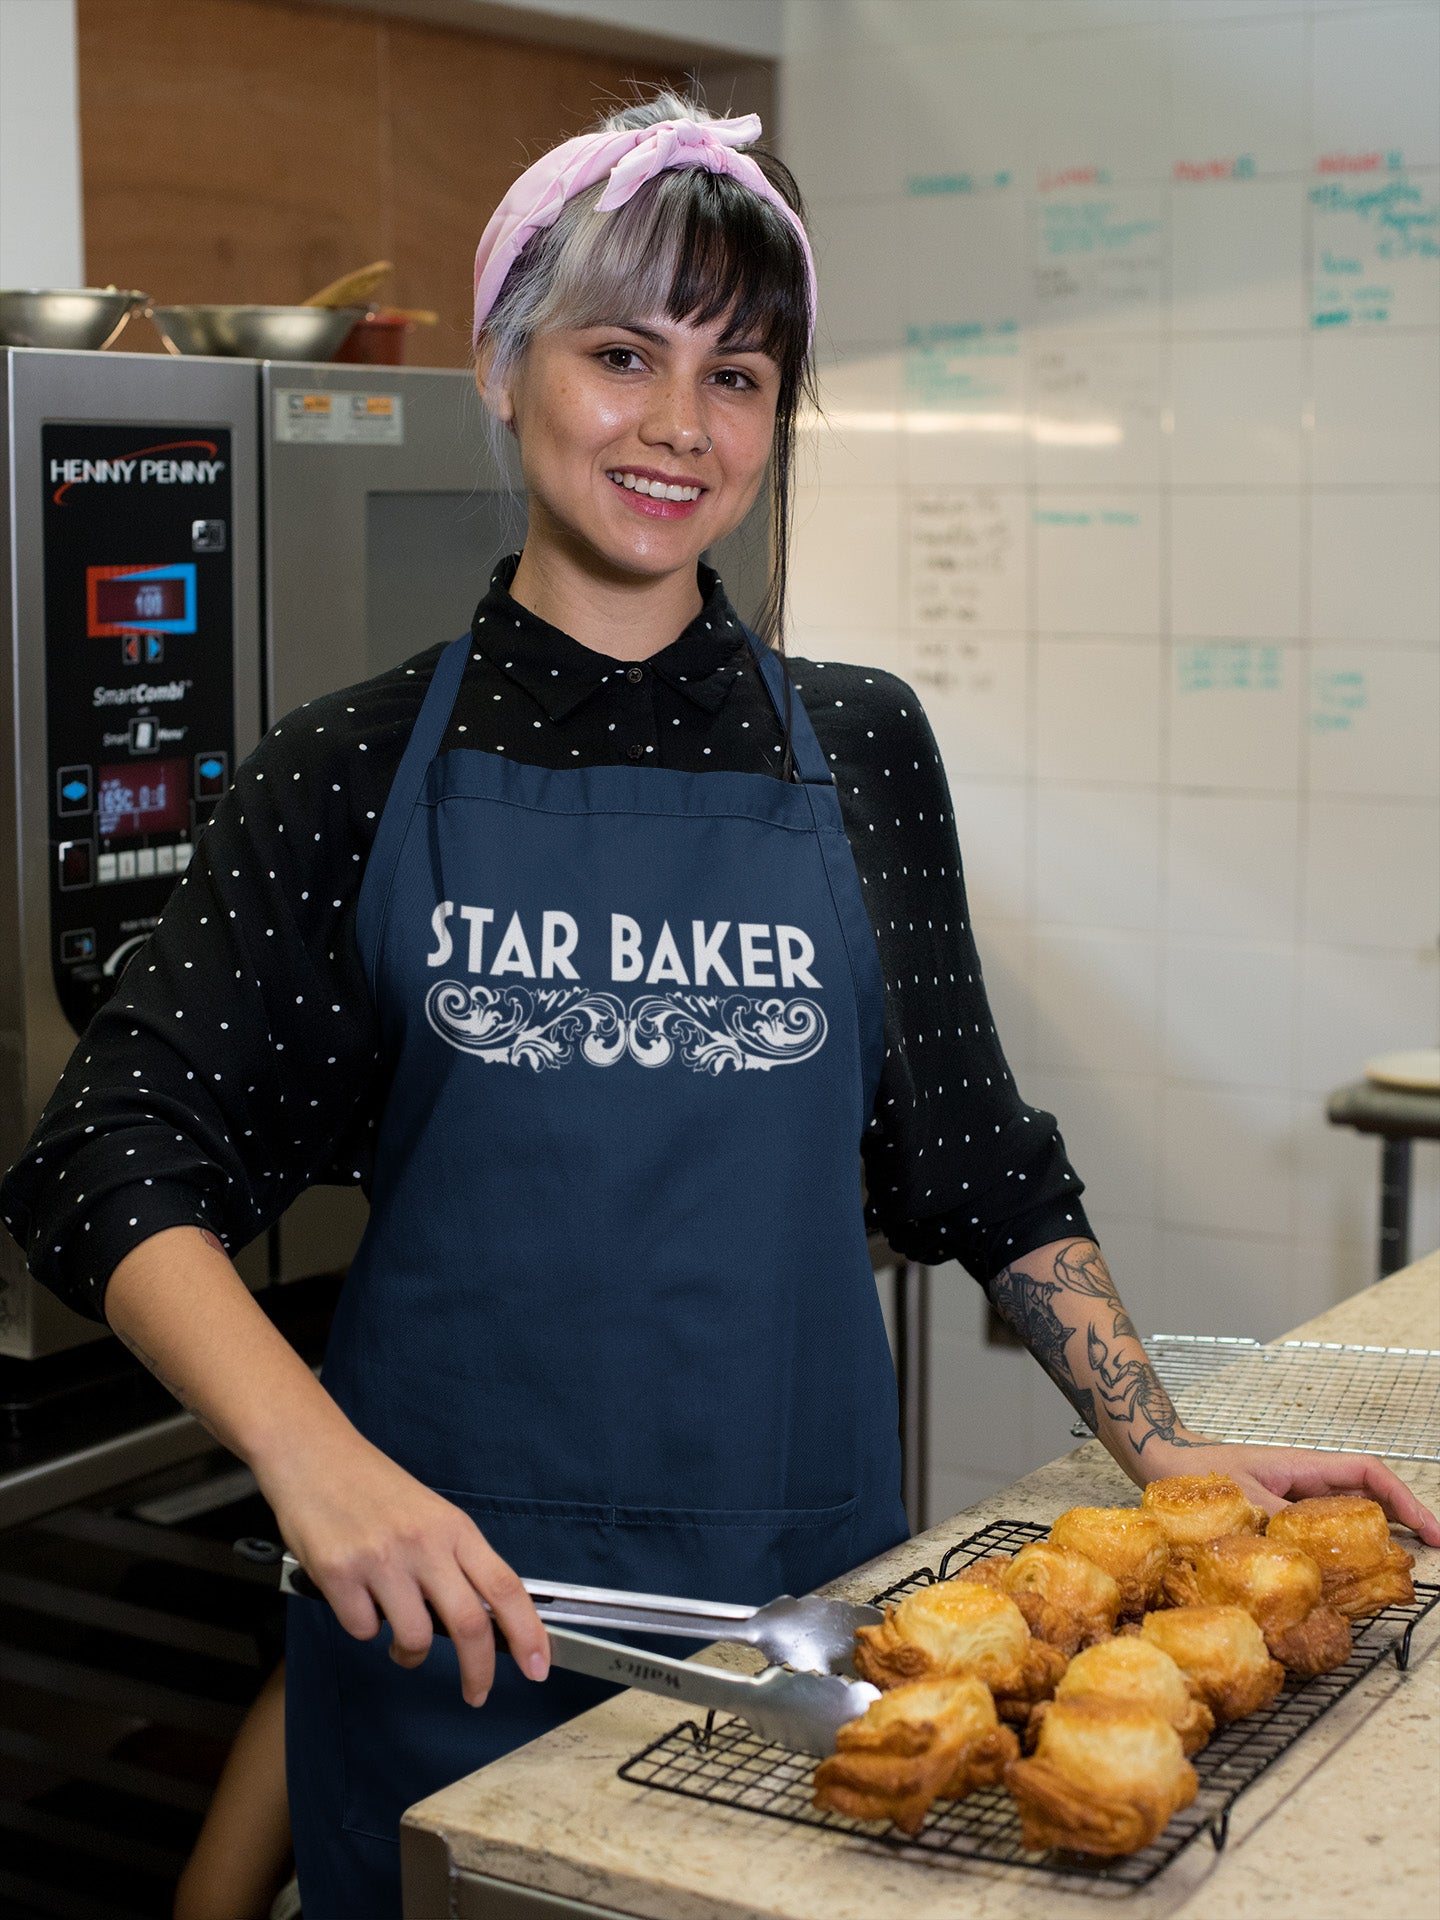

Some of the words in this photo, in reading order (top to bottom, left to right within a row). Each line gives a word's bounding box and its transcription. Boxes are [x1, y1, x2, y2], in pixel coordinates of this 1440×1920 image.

[50, 458, 137, 484] HENNY
[140, 459, 222, 484] PENNY
[427, 900, 580, 980] STAR
[611, 912, 824, 989] BAKER
